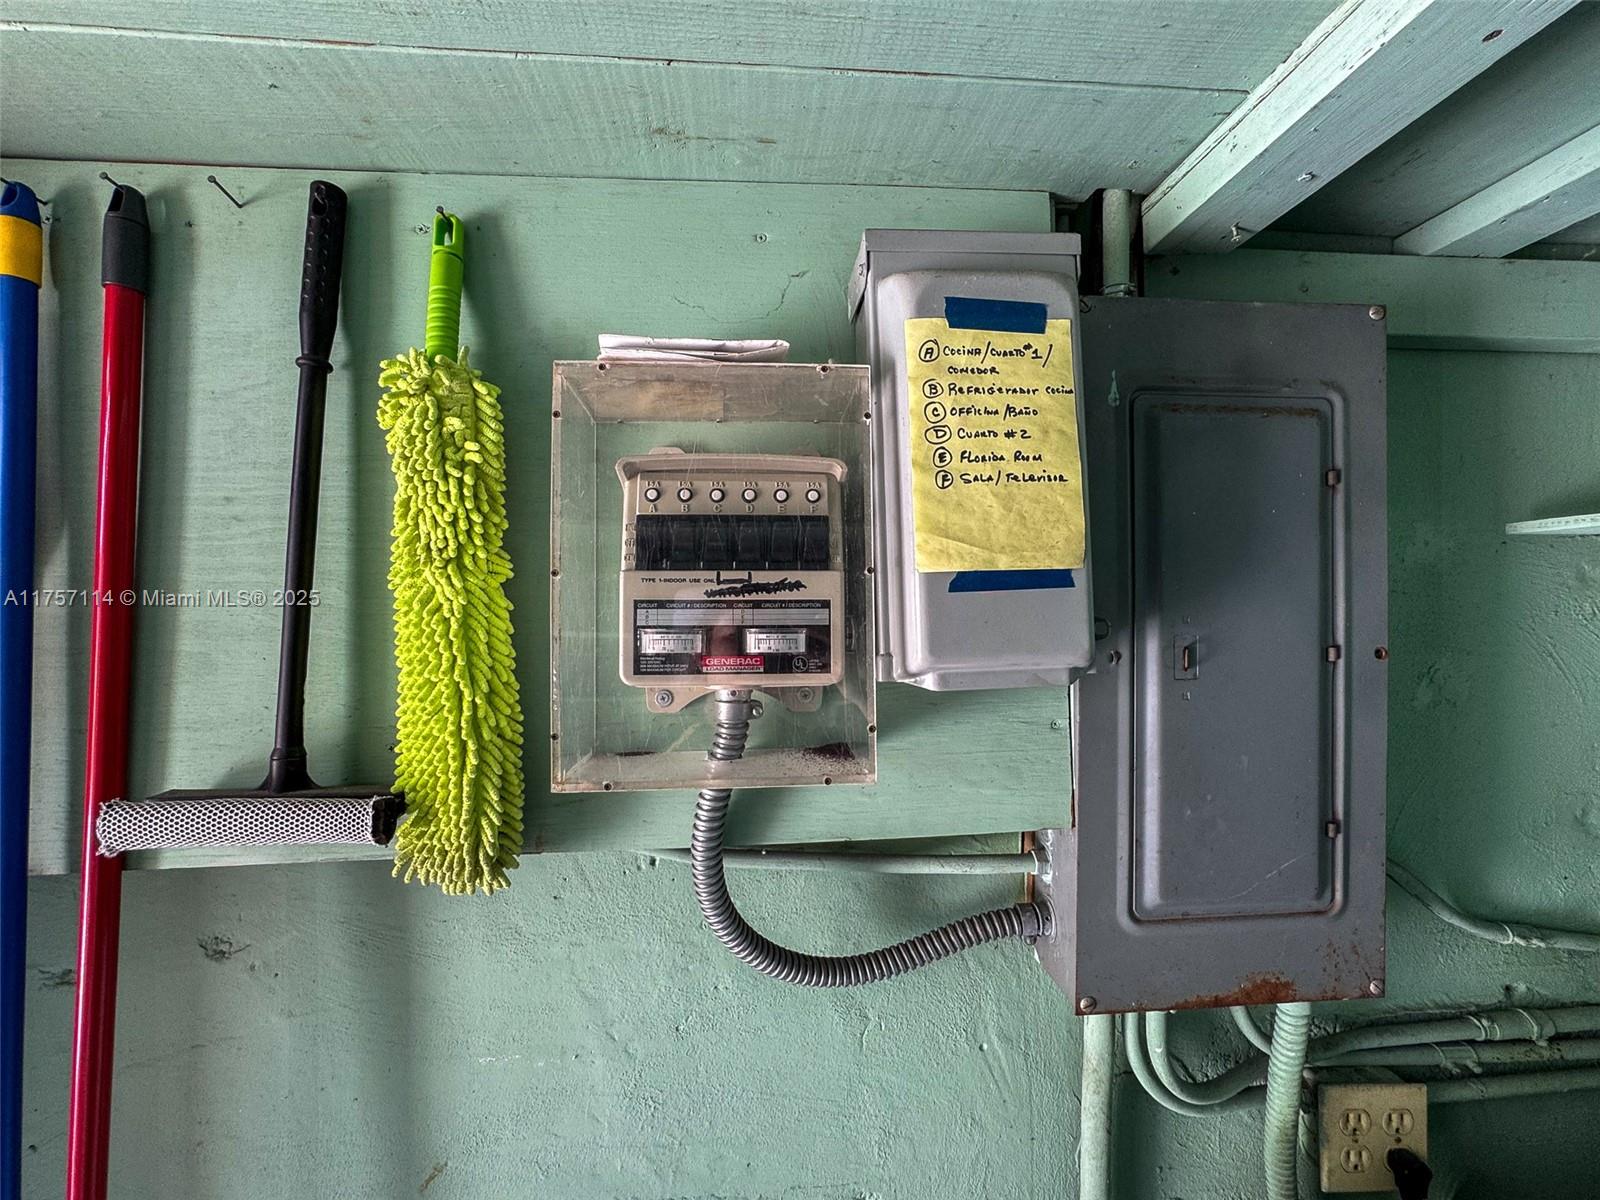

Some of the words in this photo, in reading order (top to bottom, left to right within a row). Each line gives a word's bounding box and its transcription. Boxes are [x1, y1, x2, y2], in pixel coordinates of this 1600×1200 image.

[947, 366, 1000, 375] COMEDOR
[957, 428, 999, 439] CUARTO
[959, 450, 1006, 463] FLORIDA
[1013, 451, 1042, 463] ROOM
[648, 503, 657, 513] A
[681, 503, 690, 513] B
[712, 503, 722, 513] C
[745, 504, 755, 513] D
[777, 504, 787, 513] E
[809, 504, 819, 513] F
[705, 657, 761, 666] GENERAC
